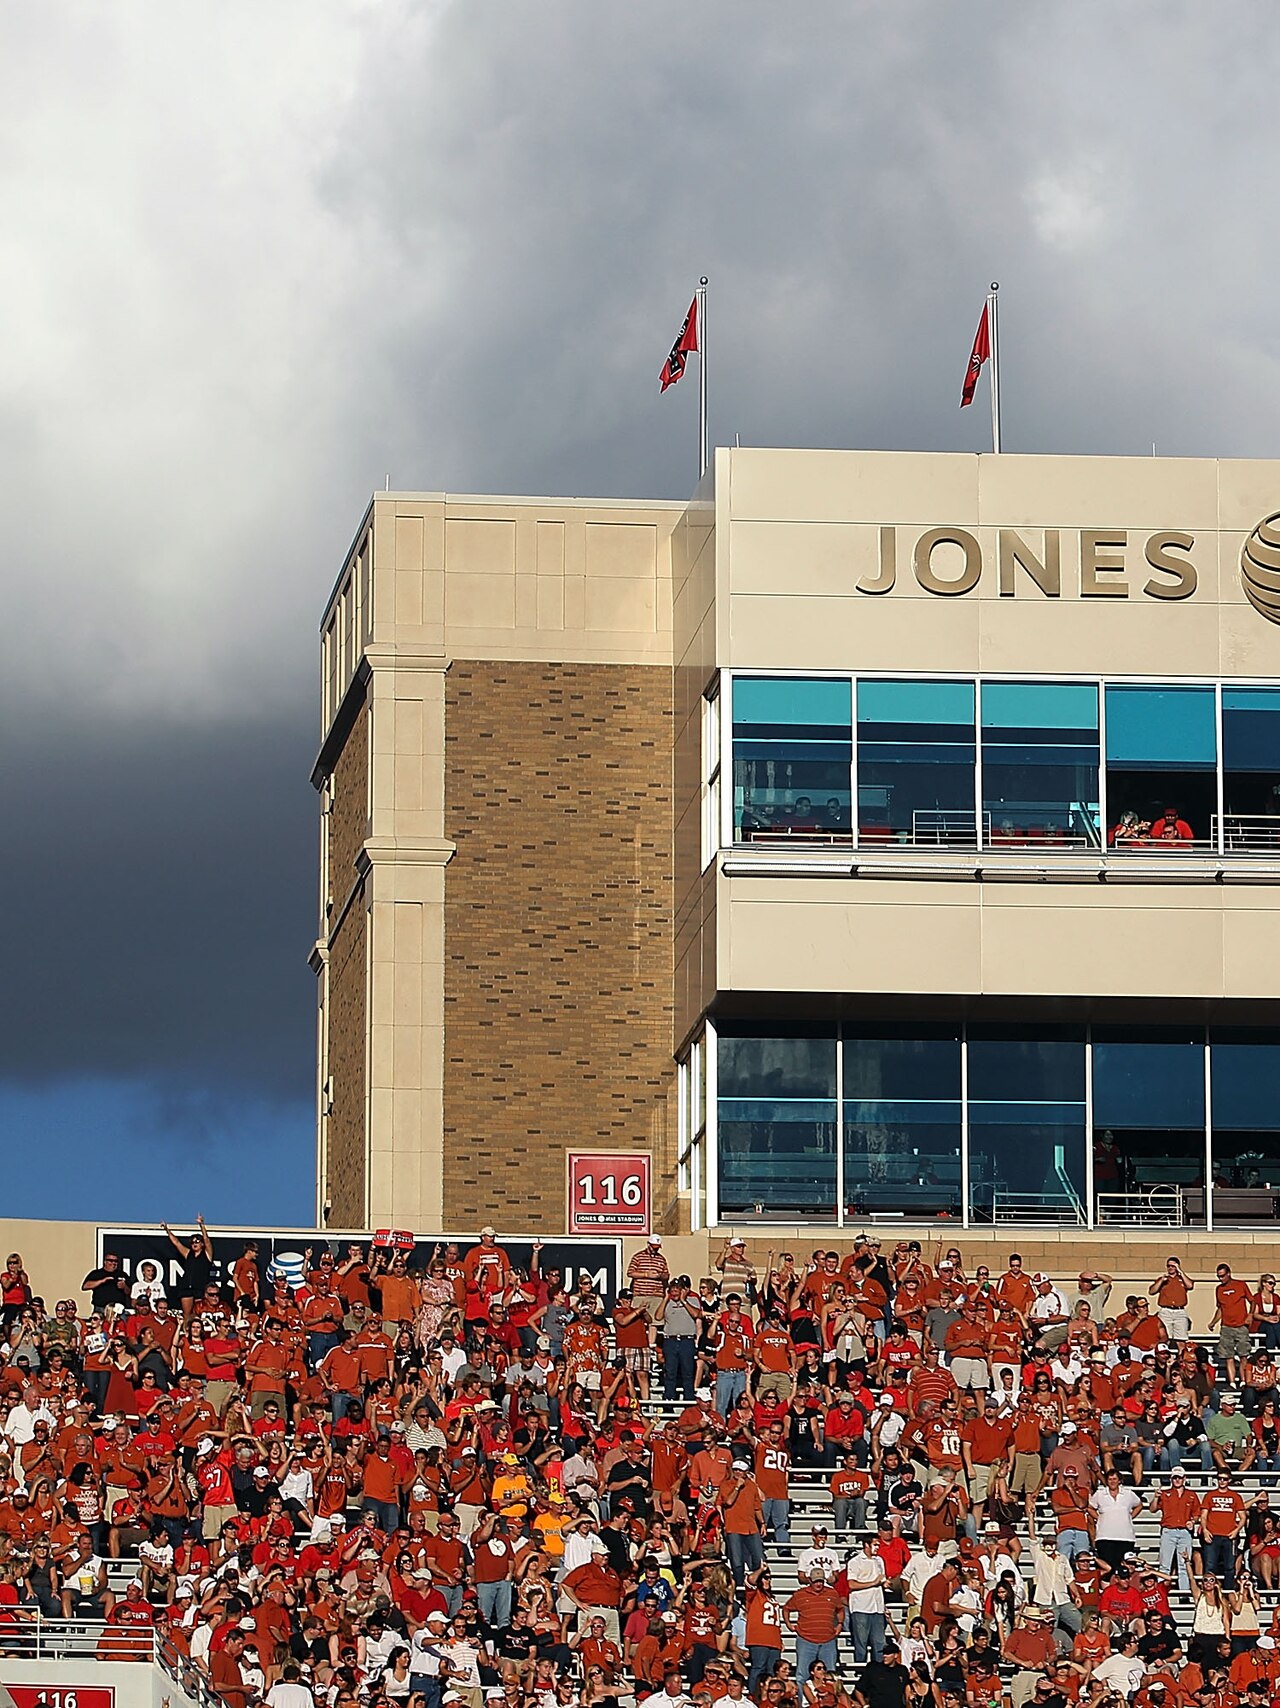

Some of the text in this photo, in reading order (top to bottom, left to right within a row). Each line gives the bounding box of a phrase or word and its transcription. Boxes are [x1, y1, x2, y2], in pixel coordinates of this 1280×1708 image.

[855, 526, 1198, 598] JONES
[578, 1174, 642, 1205] 116
[122, 1258, 236, 1288] JON
[446, 1267, 465, 1278] EXAS
[941, 1436, 960, 1455] 10
[764, 1449, 787, 1472] 20
[810, 1556, 833, 1567] TEXAS
